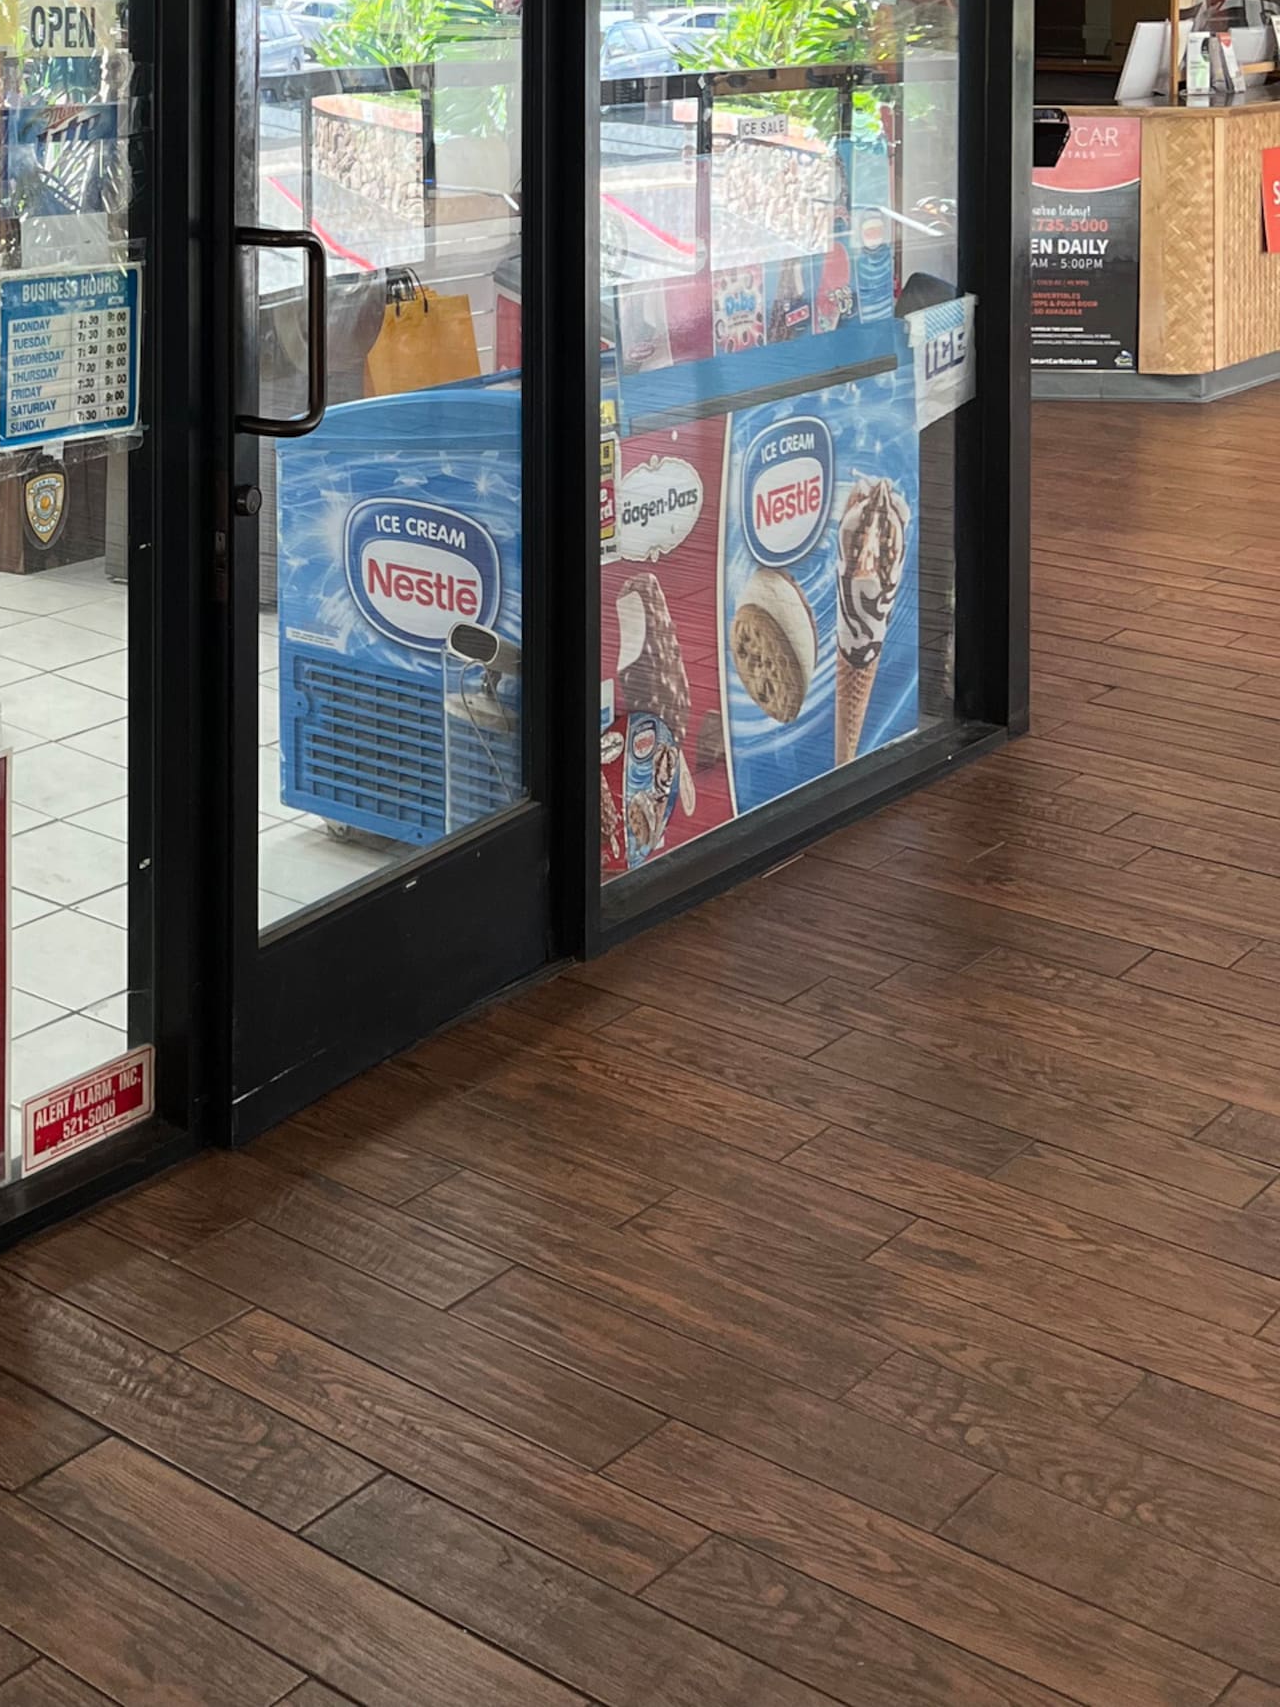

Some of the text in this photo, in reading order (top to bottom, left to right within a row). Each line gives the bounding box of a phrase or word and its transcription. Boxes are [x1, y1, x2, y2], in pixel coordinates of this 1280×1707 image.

[30, 5, 96, 48] OPEN
[740, 119, 785, 137] ICE SALE
[1032, 218, 1109, 232] .735.5000
[1031, 238, 1109, 255] EN DAILY
[1031, 258, 1048, 269] AM
[1060, 258, 1103, 269] 5:00PM
[22, 279, 79, 303] BUSINESS
[80, 276, 119, 295] HOURS
[12, 319, 51, 333] MONDAY
[12, 335, 53, 350] TUESDAY
[12, 350, 65, 367] WEDNESDAY
[925, 328, 966, 381] ICE
[11, 367, 60, 383] THURSDAY
[10, 385, 43, 401] FRIDAY
[10, 399, 57, 416] SATURDAY
[10, 418, 46, 434] SUNDAY
[760, 432, 815, 465] ICE CREAM
[621, 487, 698, 527] äagen-Dazs
[375, 514, 466, 550] ICE CREAM
[35, 1097, 71, 1131] ALERT
[73, 1078, 116, 1113] ALARM,
[118, 1067, 141, 1092] INC.
[62, 1099, 116, 1139] 521-5000
